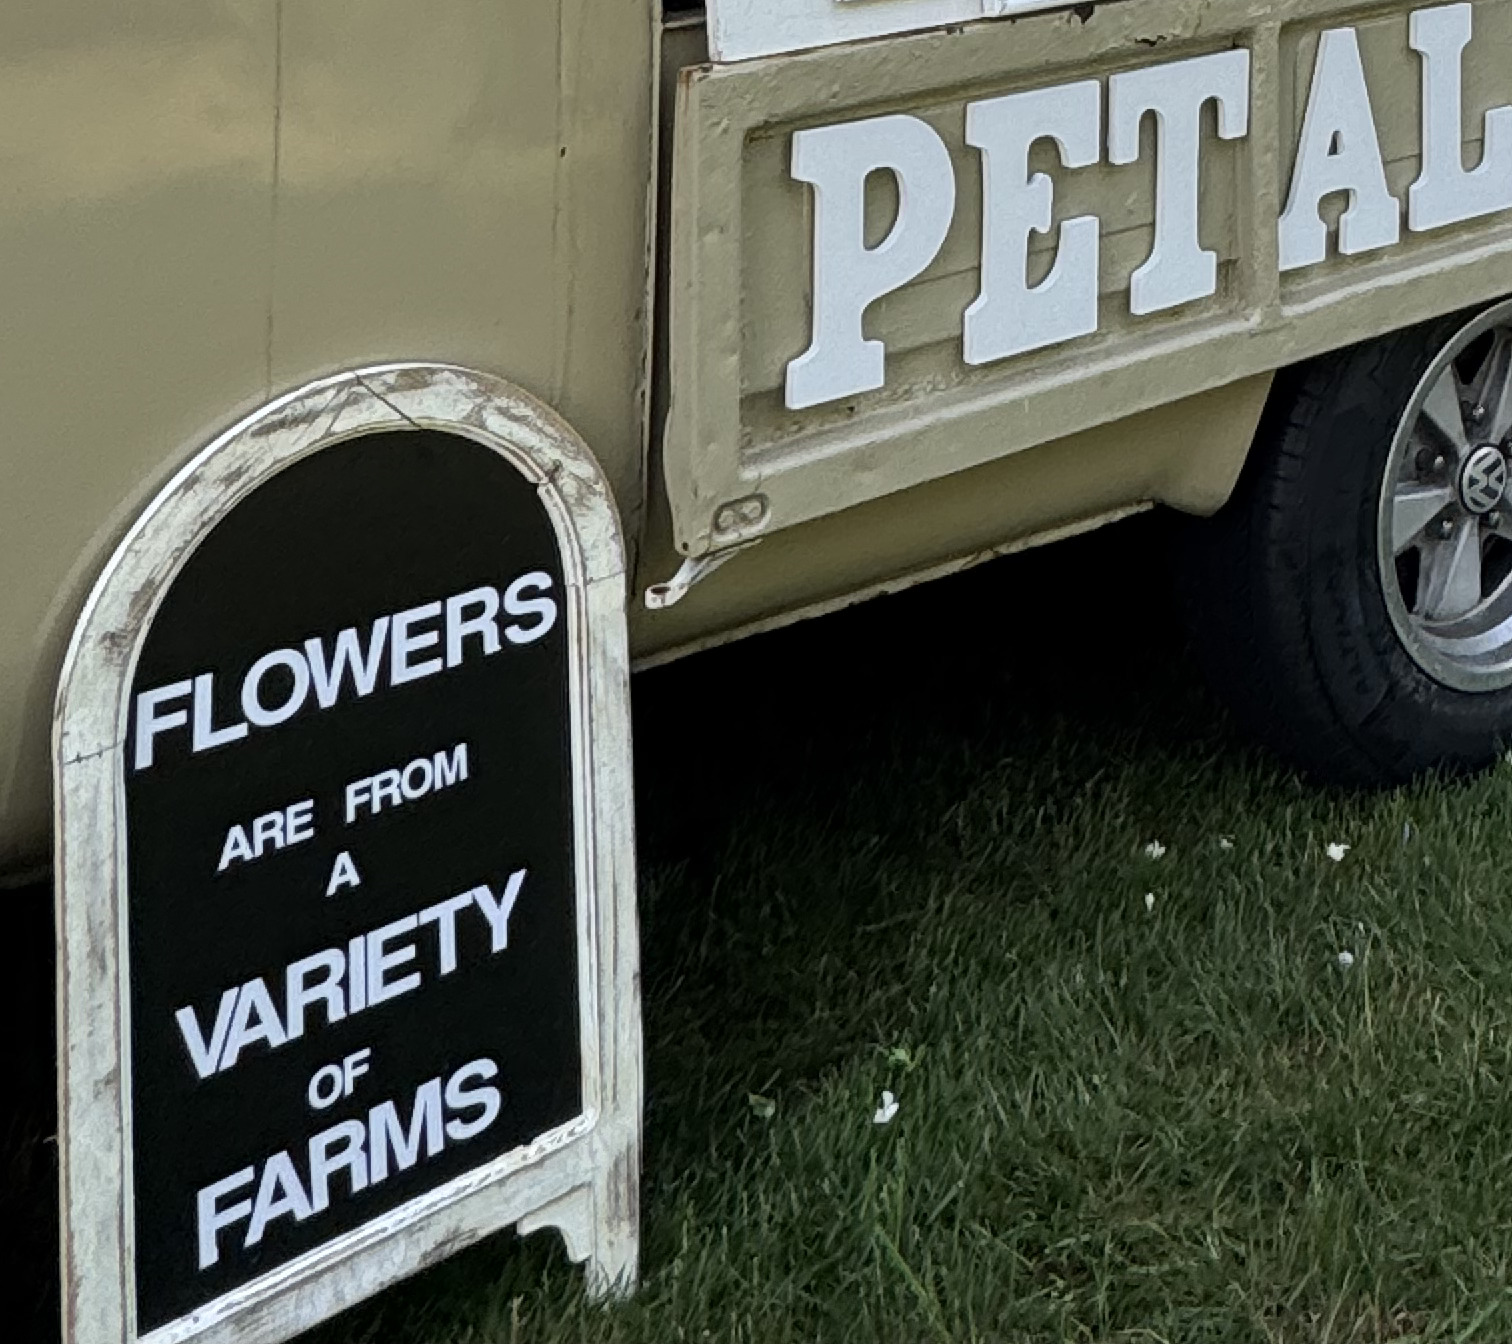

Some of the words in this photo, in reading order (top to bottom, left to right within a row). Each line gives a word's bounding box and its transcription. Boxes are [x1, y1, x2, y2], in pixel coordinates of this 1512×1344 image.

[134, 569, 558, 771] FLOWERS
[216, 799, 316, 873] ARE
[344, 742, 469, 825] FROM
[325, 850, 362, 898] A
[175, 867, 528, 1081] VARIETY
[307, 1047, 372, 1110] OF
[197, 1056, 502, 1272] FARMS
